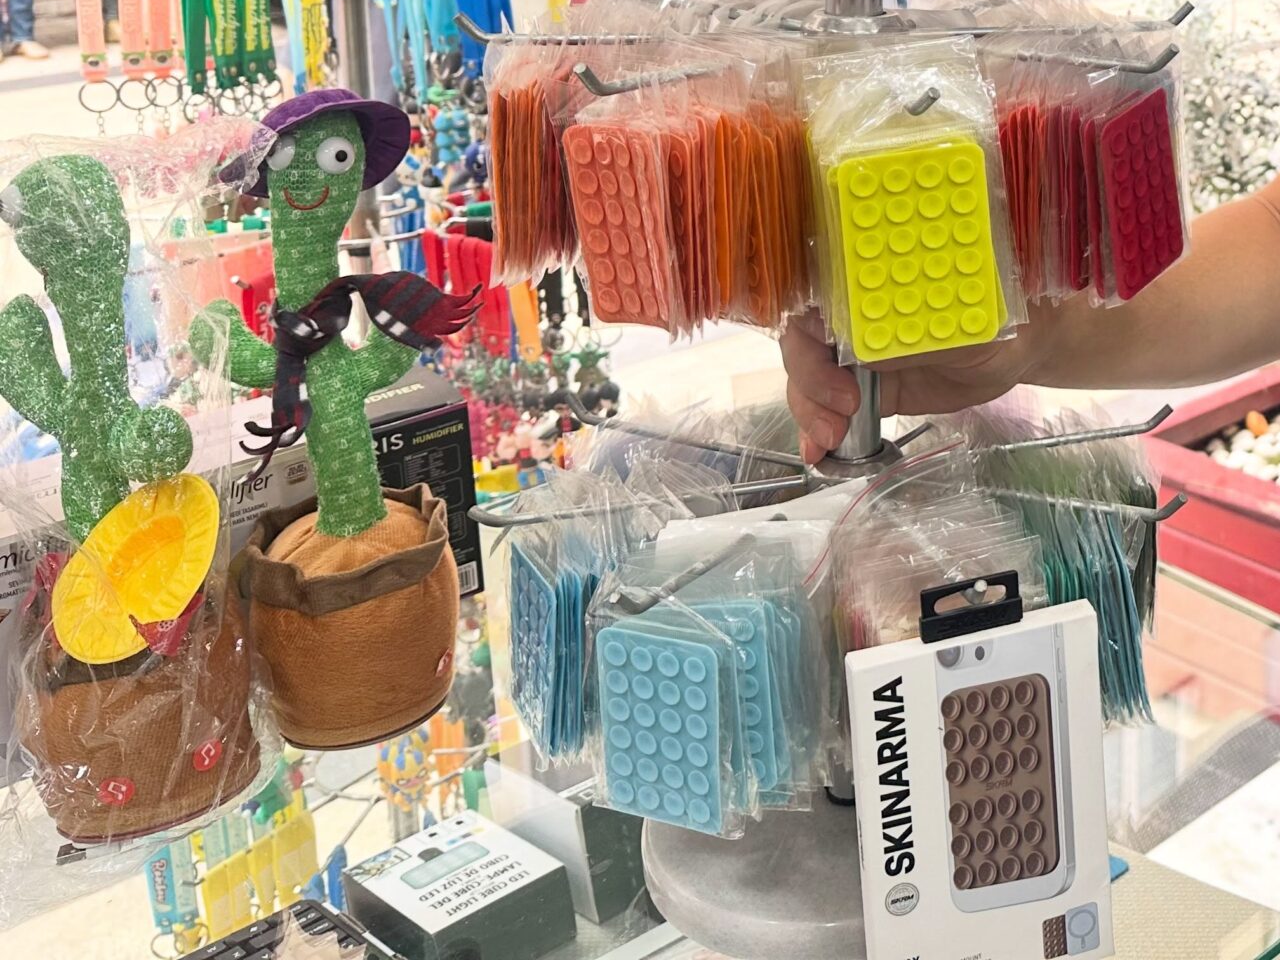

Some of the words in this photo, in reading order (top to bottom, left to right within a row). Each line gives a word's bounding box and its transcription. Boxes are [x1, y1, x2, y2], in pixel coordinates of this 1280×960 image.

[412, 422, 465, 446] HUMIDIFIER
[872, 675, 916, 878] SKINARMA
[479, 854, 510, 870] CUBO
[464, 867, 479, 878] DE
[509, 869, 531, 884] LED
[442, 876, 463, 890] LUZ
[479, 881, 508, 899] CUBE
[418, 887, 441, 901] LED
[429, 895, 452, 910] DEL
[445, 896, 479, 917] LIGHT
